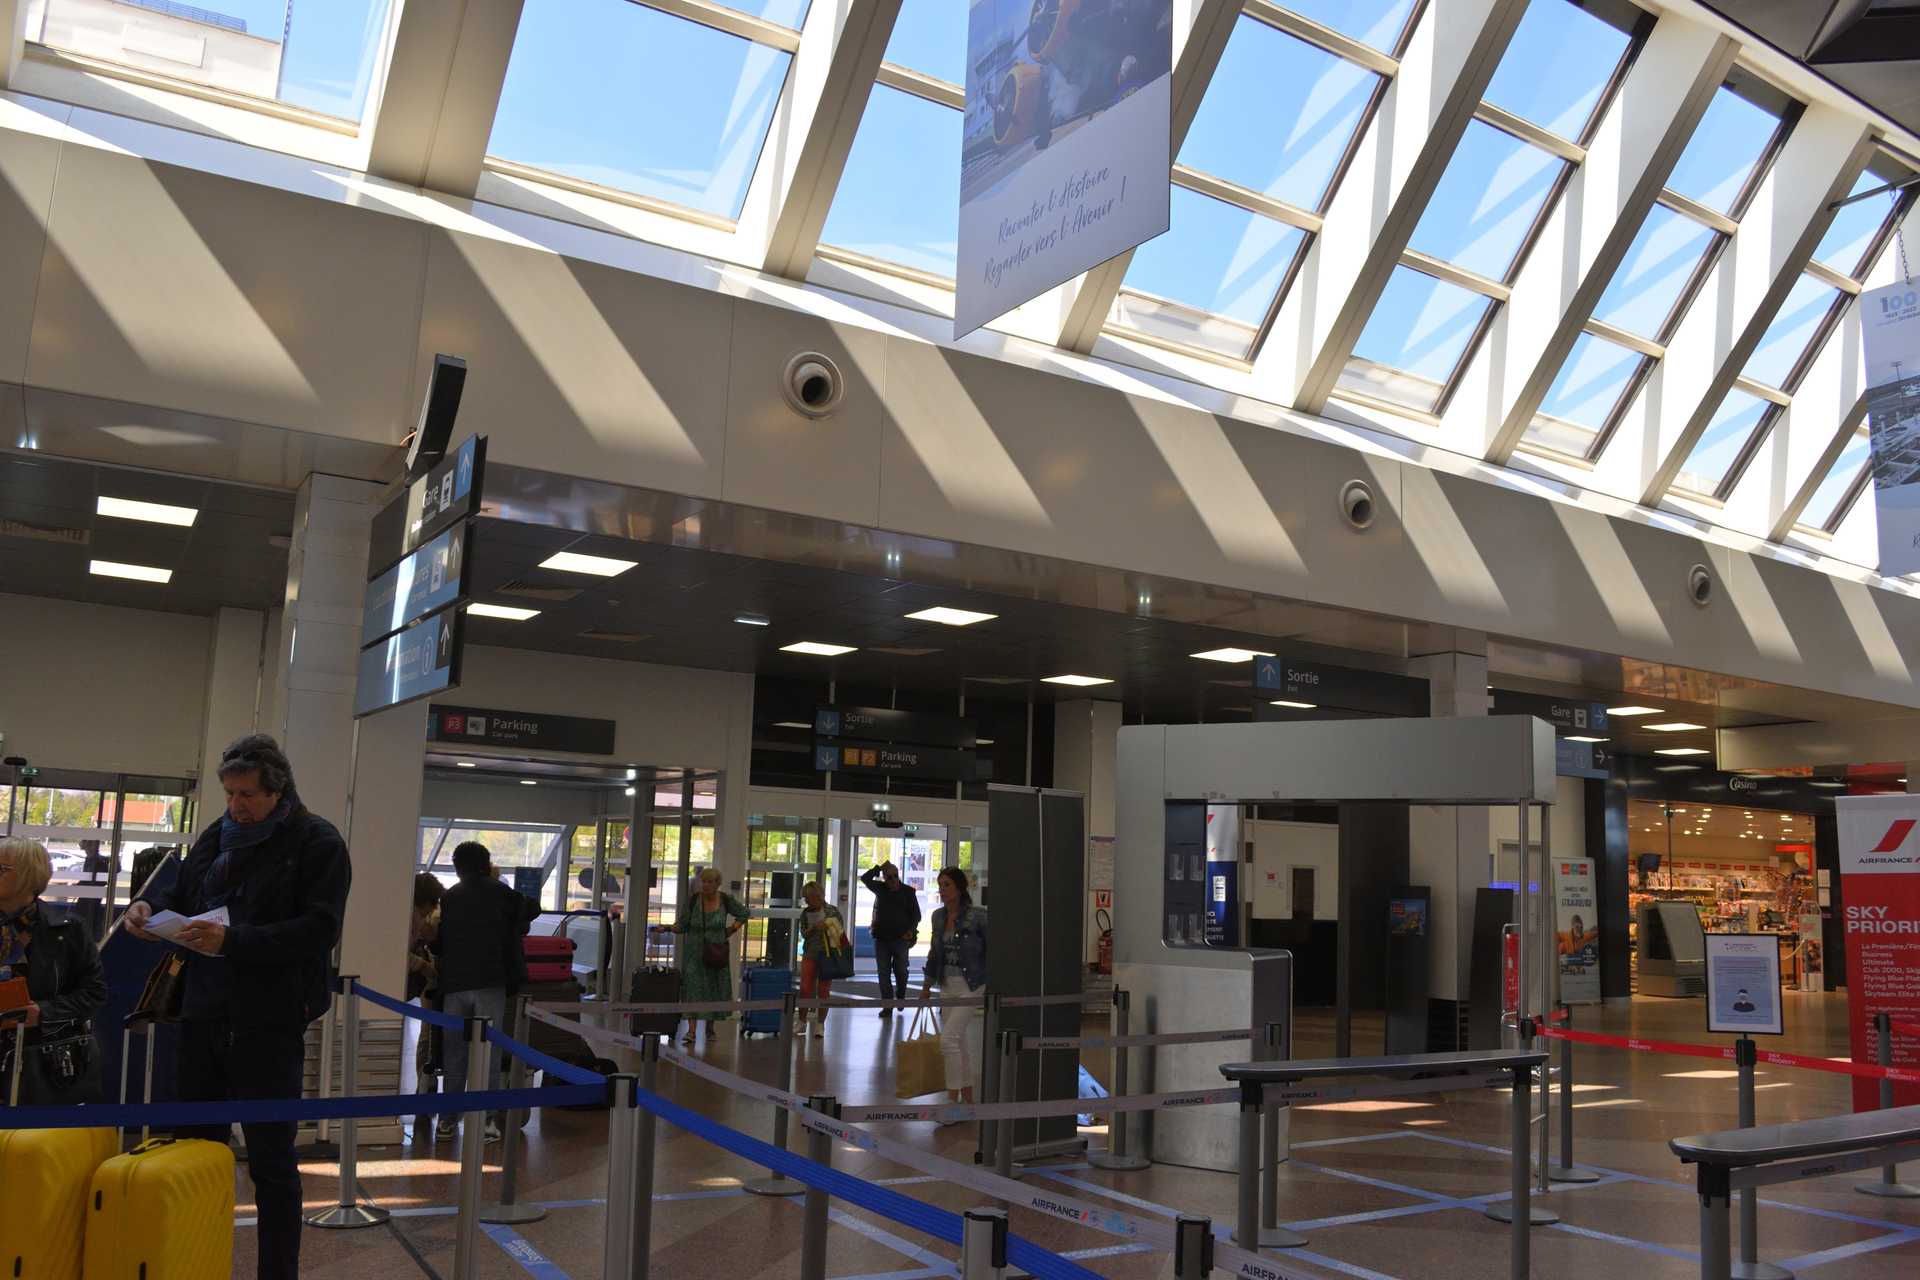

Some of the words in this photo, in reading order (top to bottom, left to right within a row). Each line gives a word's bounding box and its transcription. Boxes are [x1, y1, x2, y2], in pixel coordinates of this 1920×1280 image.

[998, 200, 1044, 245] Raconter
[984, 240, 1032, 288] Regarder
[1035, 230, 1057, 255] vers
[1120, 176, 1126, 206] !
[1287, 668, 1320, 685] Sortie
[844, 712, 874, 725] Sortie
[1551, 705, 1571, 719] Gare
[493, 717, 538, 735] Parking
[881, 750, 918, 766] Parking
[1729, 776, 1757, 791] Casino
[1858, 856, 1913, 864] AIRFRANCE
[1846, 905, 1888, 919] SKY
[1847, 920, 1920, 934] PRIORI
[1864, 975, 1887, 983] Flying
[1864, 983, 1887, 991] Flying
[1162, 1096, 1205, 1106] AIRFRANCE
[865, 1112, 919, 1121] AIRFRANCE
[814, 1119, 844, 1138] AIRFRANCE
[1031, 1197, 1081, 1220] AIRFRANCE
[1241, 1263, 1290, 1280] AIRFRA
